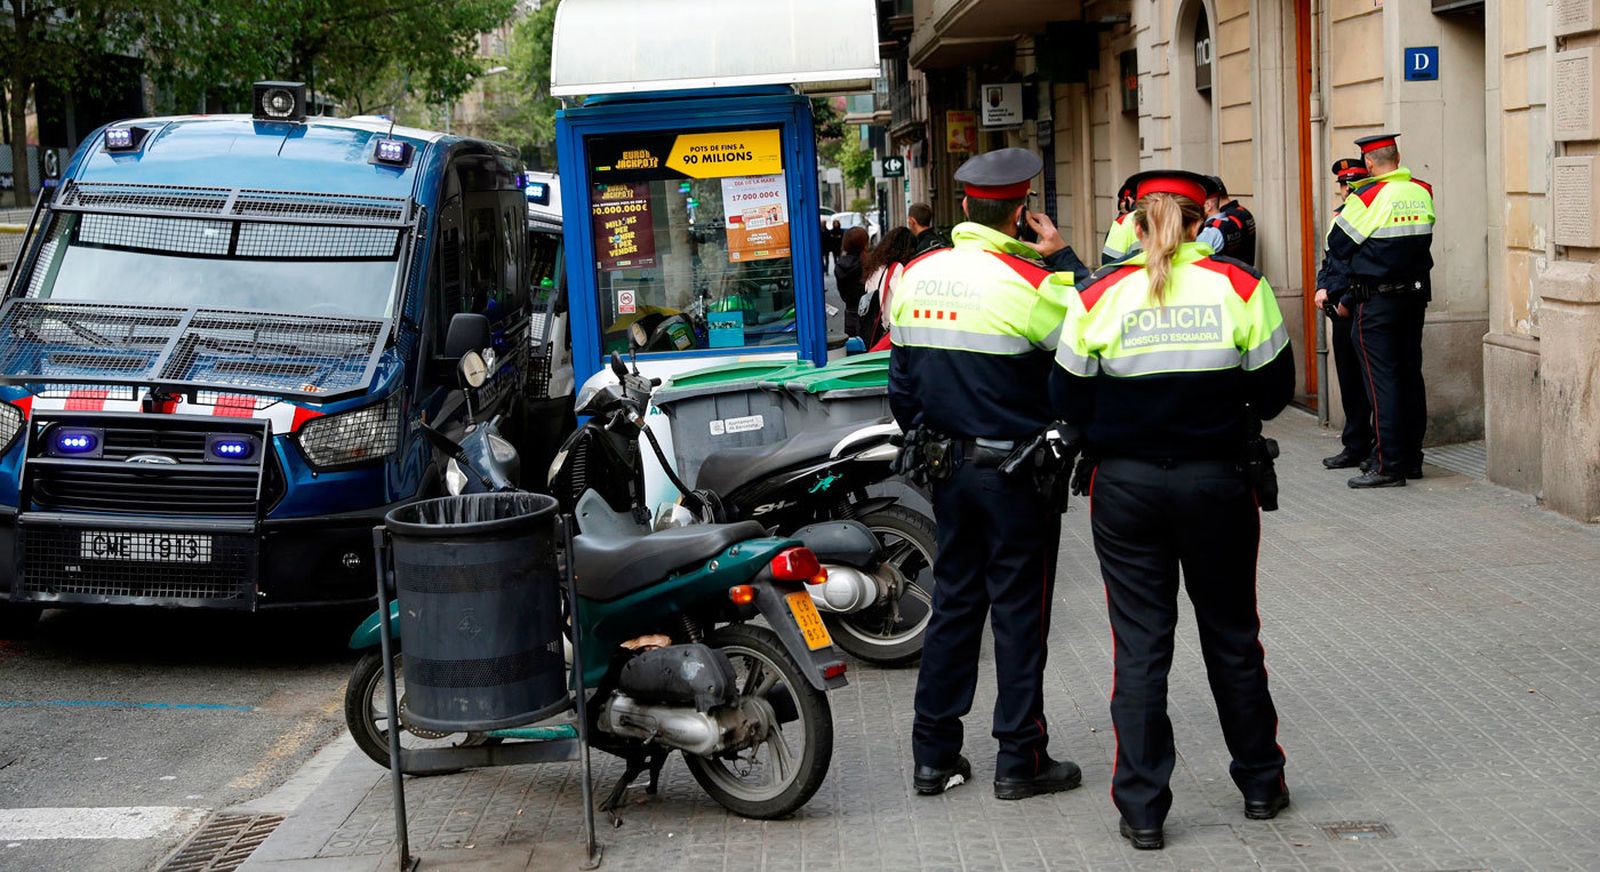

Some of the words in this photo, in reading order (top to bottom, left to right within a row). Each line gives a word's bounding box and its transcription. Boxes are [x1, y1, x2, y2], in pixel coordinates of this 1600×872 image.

[1414, 53, 1430, 70] D
[683, 155, 698, 164] 90
[702, 151, 753, 163] MILIONS
[1123, 306, 1219, 334] POLICIA
[1124, 335, 1160, 347] MOSSOS
[1161, 332, 1219, 344] D'ESQUADRA
[93, 536, 131, 557] CME
[149, 537, 199, 560] 1913
